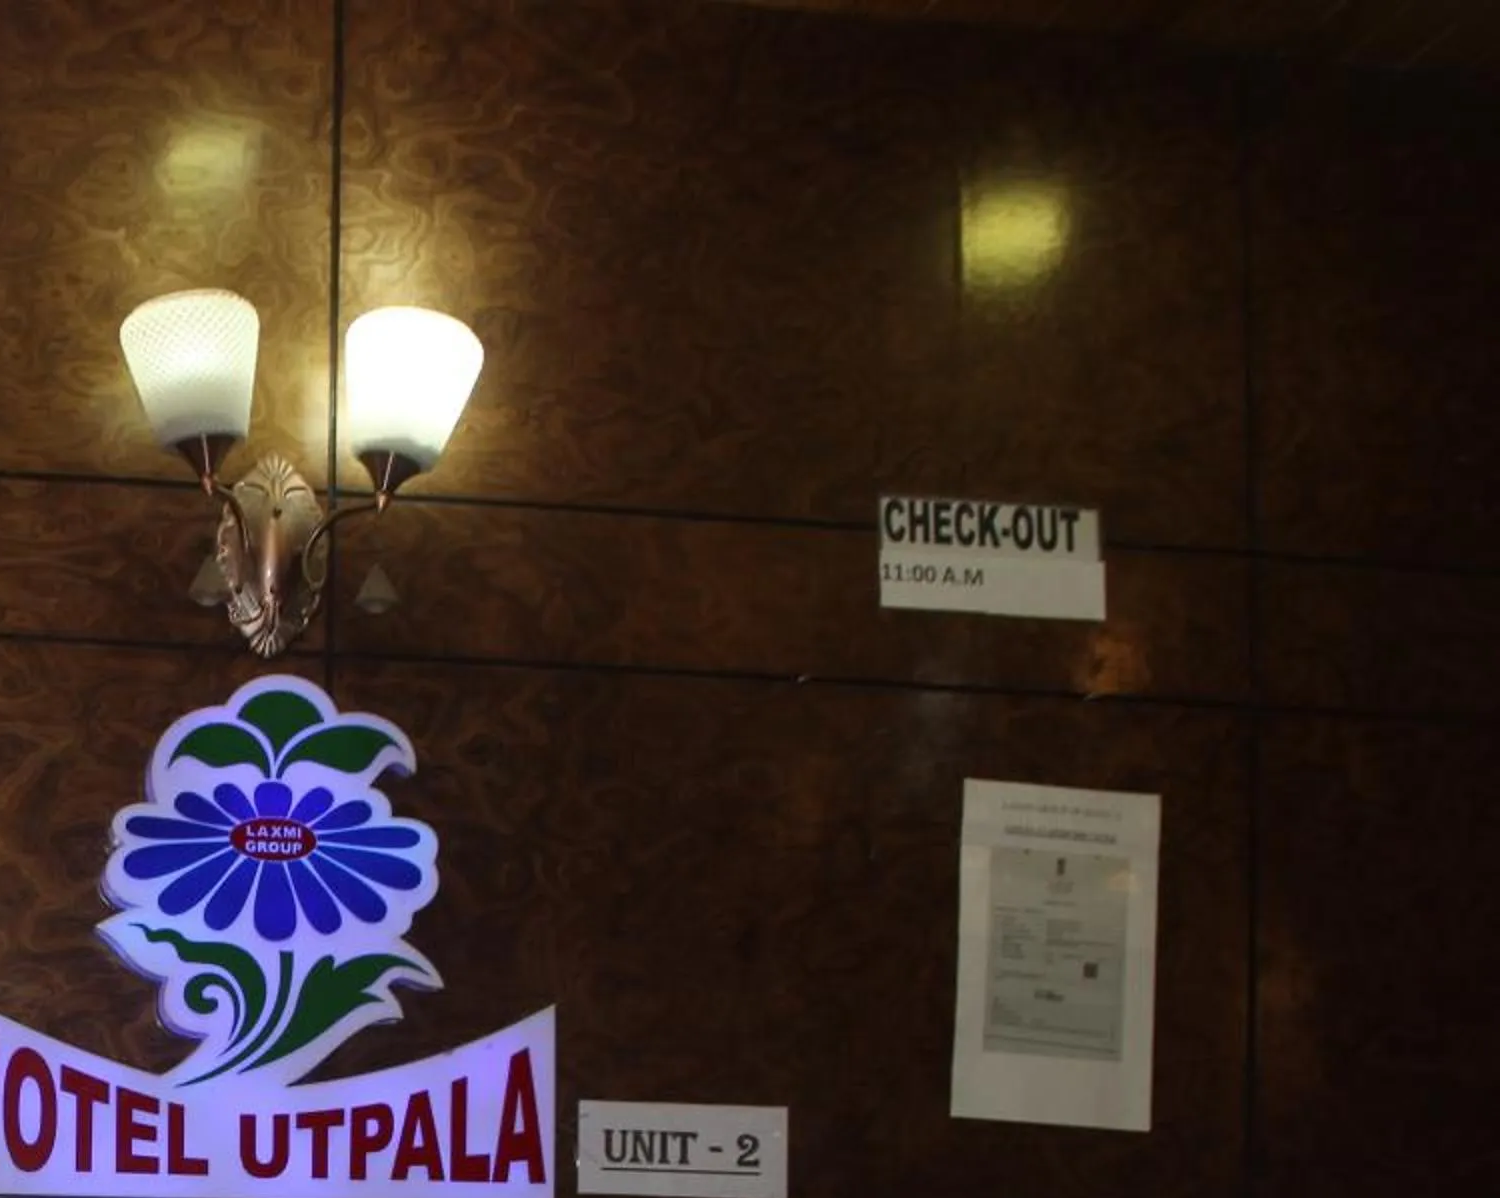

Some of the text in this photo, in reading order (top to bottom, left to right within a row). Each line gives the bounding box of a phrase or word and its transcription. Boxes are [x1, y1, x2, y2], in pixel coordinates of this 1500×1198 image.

[885, 500, 1080, 552] CHECK-OUT
[883, 564, 936, 583] 11:00
[245, 825, 302, 840] LAXMI
[245, 840, 302, 854] GROUP
[239, 1047, 546, 1184] UTPALA
[603, 1129, 698, 1165] UNIT
[737, 1134, 760, 1167] 2
